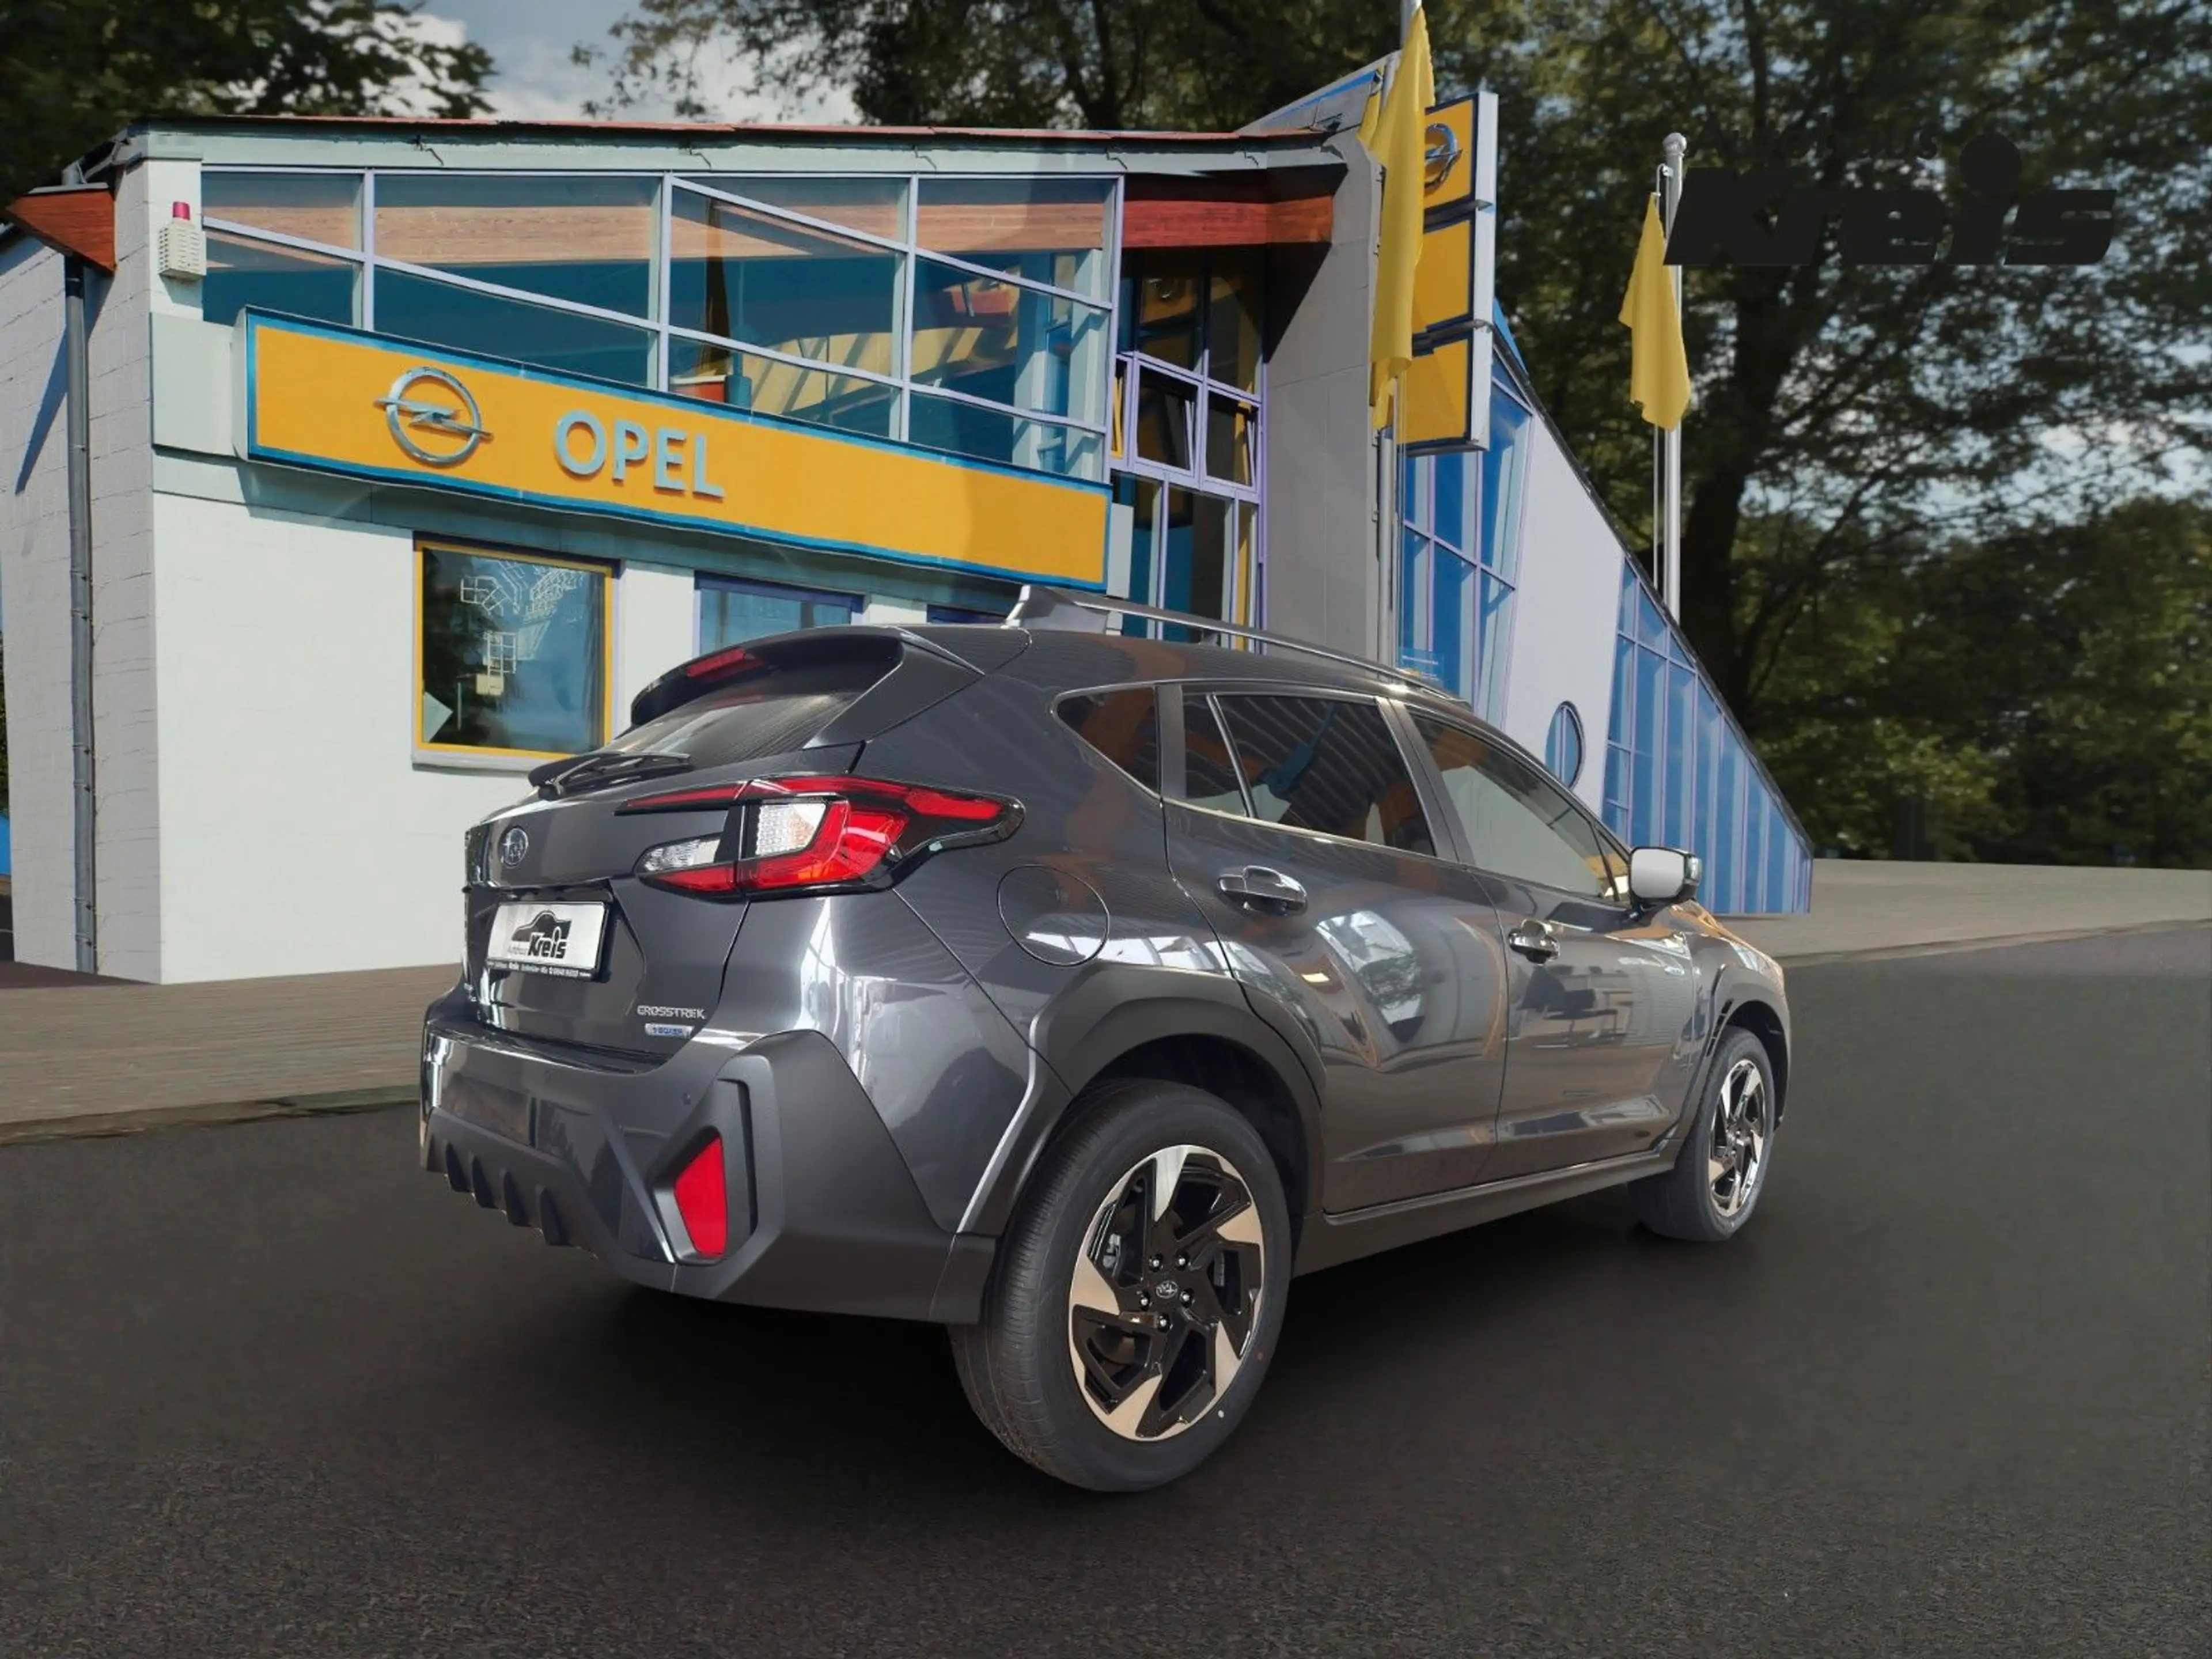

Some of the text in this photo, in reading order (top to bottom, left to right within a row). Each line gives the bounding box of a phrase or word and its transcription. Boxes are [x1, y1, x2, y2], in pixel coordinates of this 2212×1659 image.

[555, 411, 724, 497] OPEL
[528, 927, 567, 959] Kreis
[637, 1005, 706, 1020] CROSSTREK
